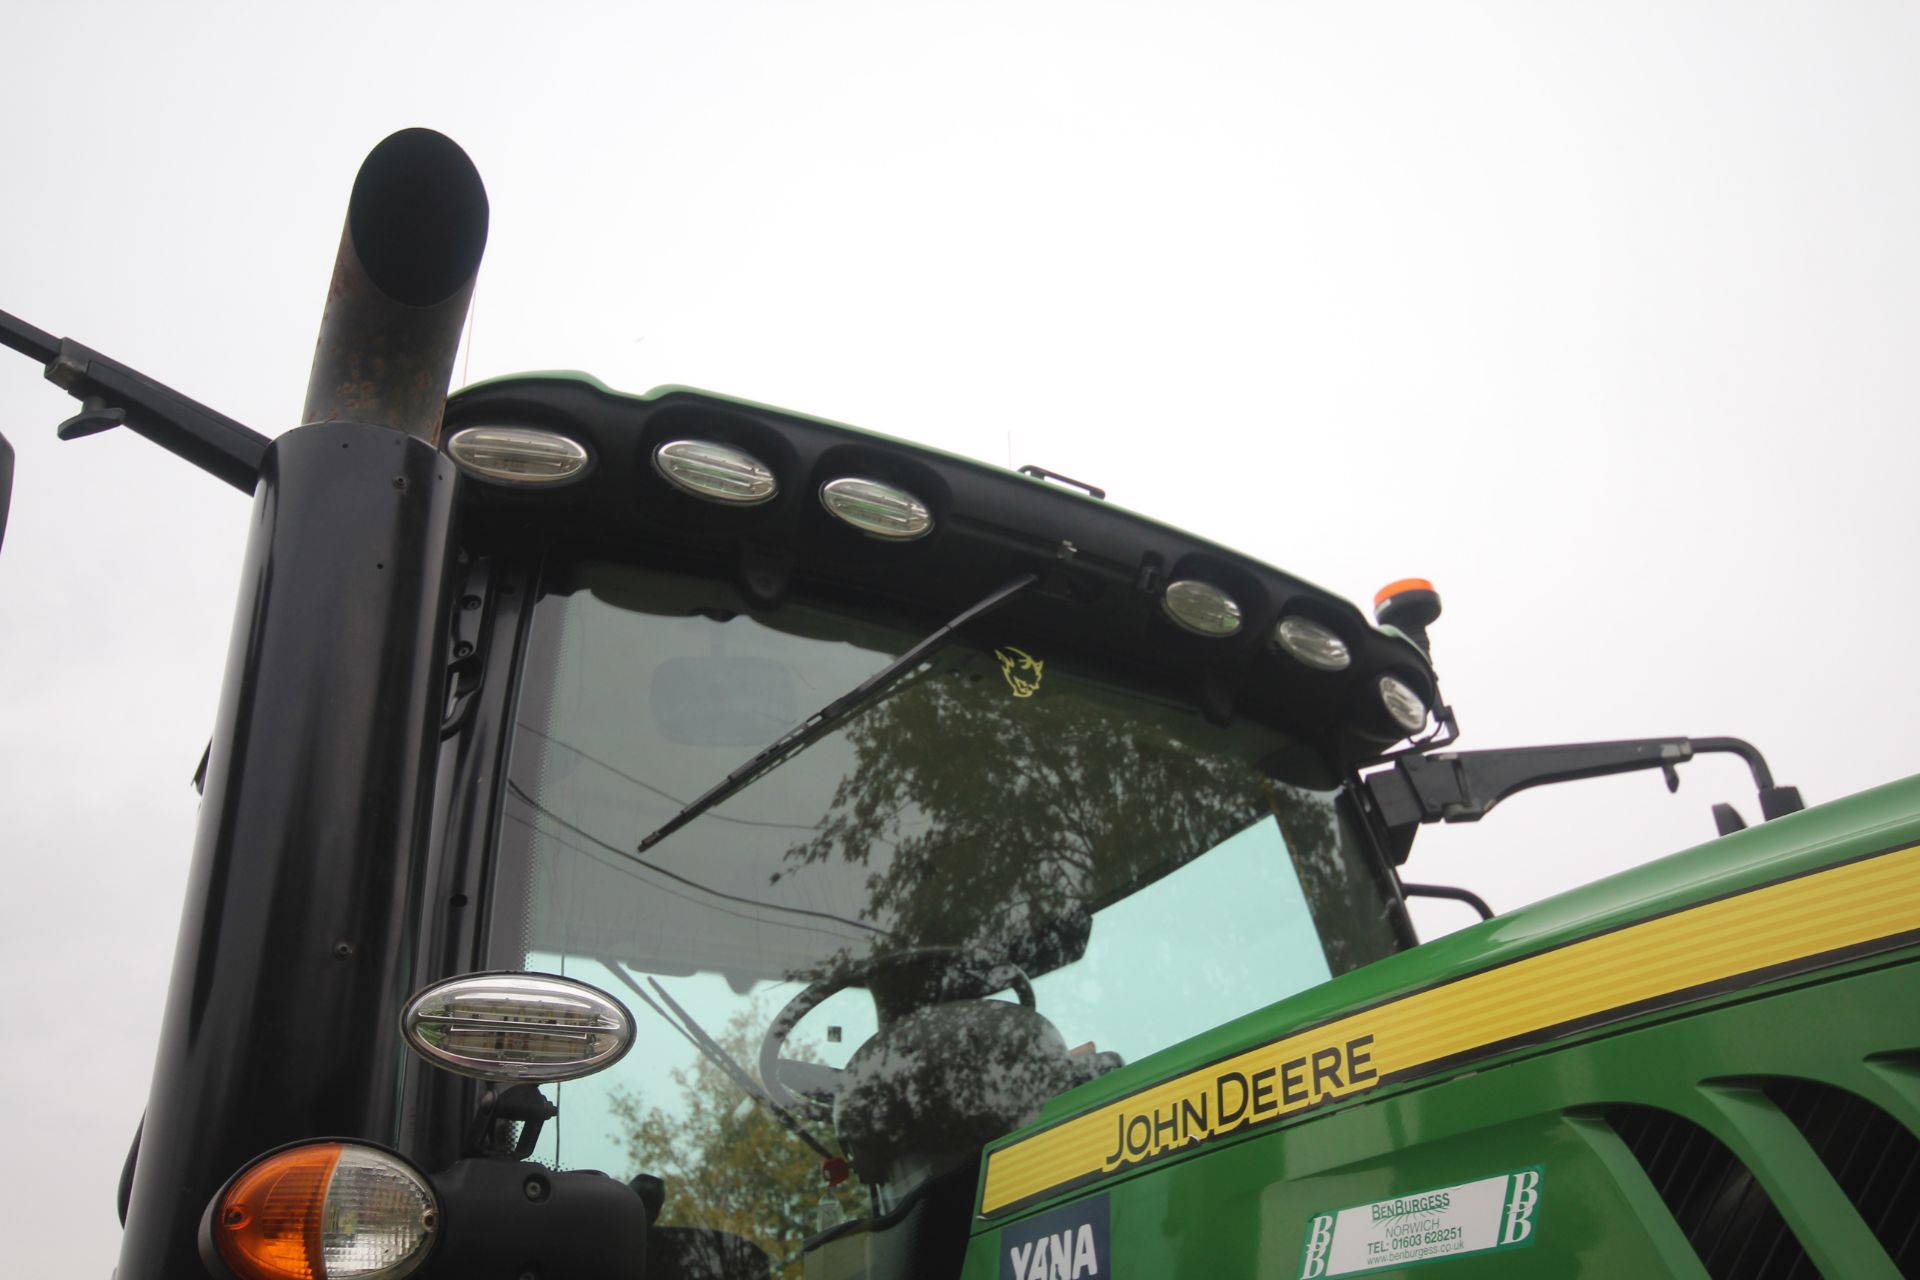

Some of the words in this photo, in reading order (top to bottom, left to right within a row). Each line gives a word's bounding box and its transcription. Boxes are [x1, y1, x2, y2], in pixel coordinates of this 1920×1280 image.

[1106, 1091, 1209, 1165] JOHN
[1217, 1034, 1377, 1124] DEERE
[1367, 1241, 1389, 1255] TEL:
[1391, 1235, 1422, 1251] 01603
[1425, 1226, 1463, 1245] 628251
[1385, 1218, 1440, 1238] NORWICH
[1010, 1222, 1099, 1280] YANA
[1367, 1240, 1465, 1266] www.benburgess.co.uk
